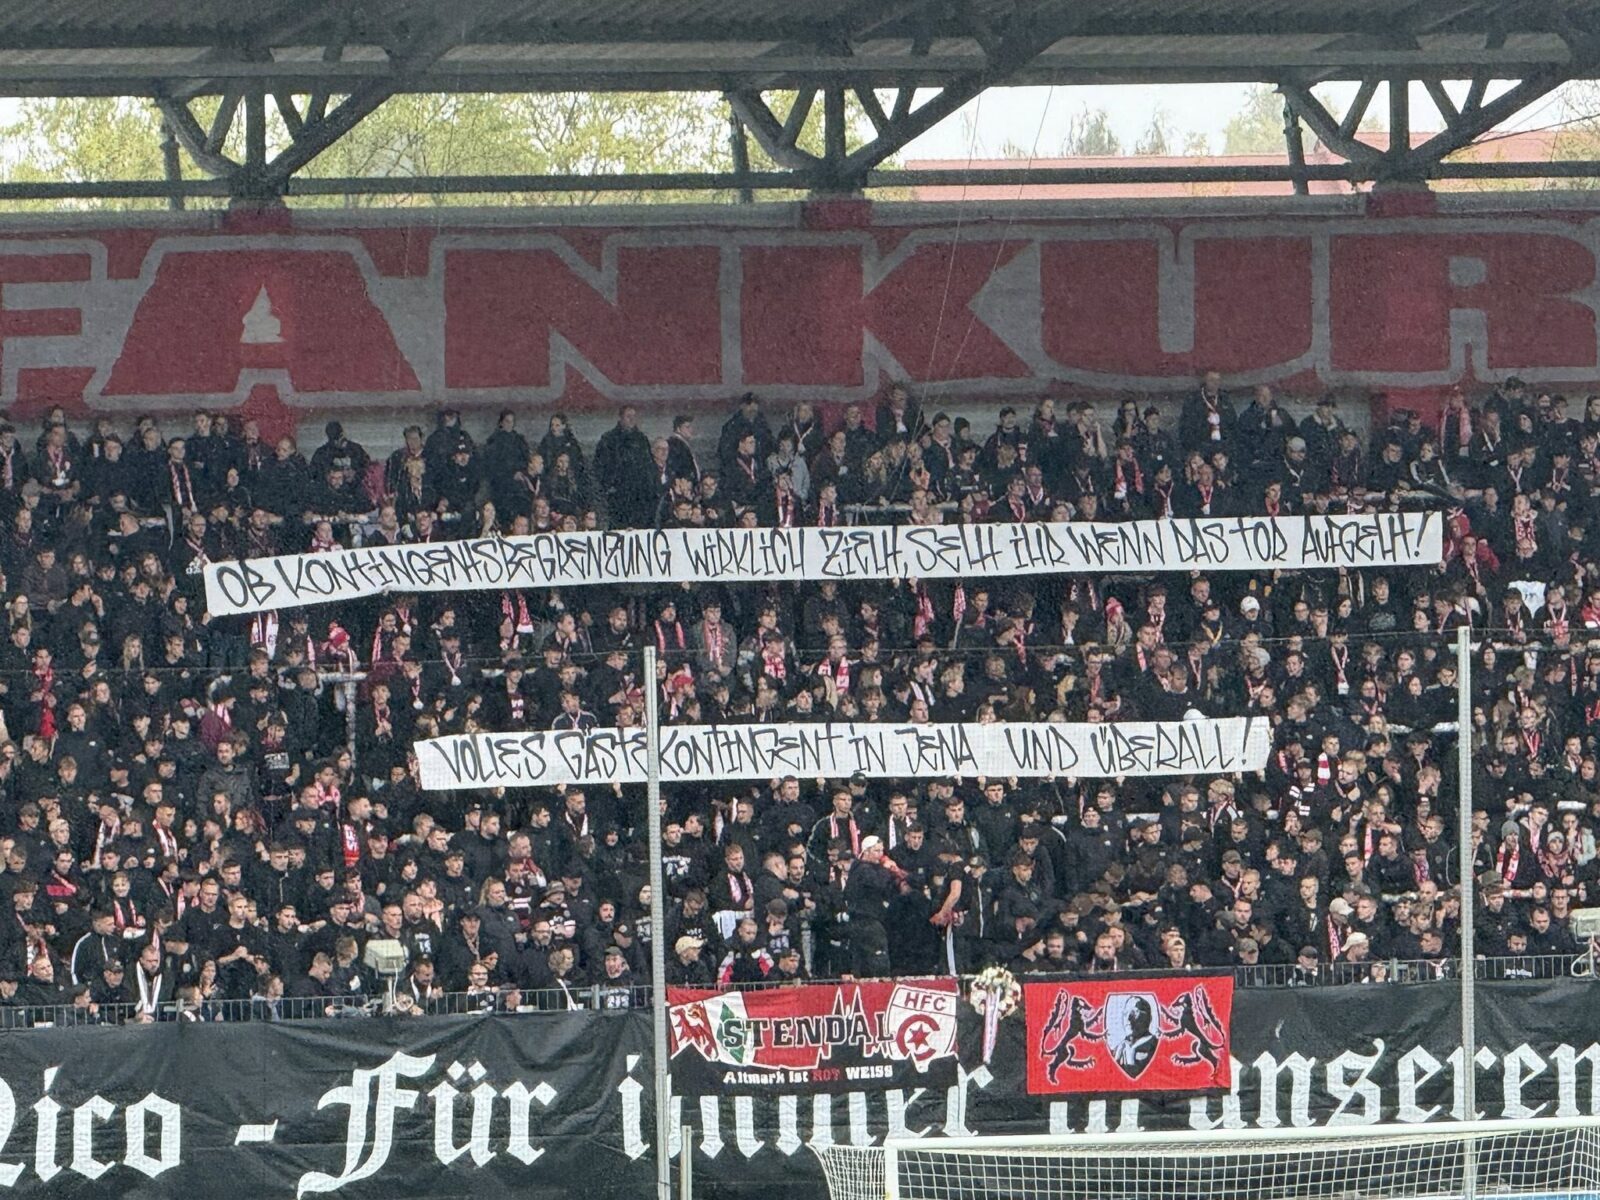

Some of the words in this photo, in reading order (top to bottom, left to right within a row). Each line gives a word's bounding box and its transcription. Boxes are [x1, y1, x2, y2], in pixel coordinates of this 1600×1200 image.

[216, 559, 276, 607] OB
[906, 525, 1003, 573] SEHT
[1067, 520, 1165, 566] WENN
[1169, 519, 1229, 563] DAS
[1229, 516, 1289, 562] TOR
[1302, 511, 1433, 564] AUFGEHT!
[430, 733, 547, 783] VOLLES
[895, 724, 979, 775] JENA
[1005, 724, 1080, 770] UND
[1090, 717, 1255, 775] ÜBERALL!
[720, 1008, 895, 1050] STENDAL
[904, 992, 946, 1012] HFC
[723, 1070, 785, 1084] Altmark
[845, 1065, 894, 1080] WEISS
[298, 1051, 557, 1200] Für
